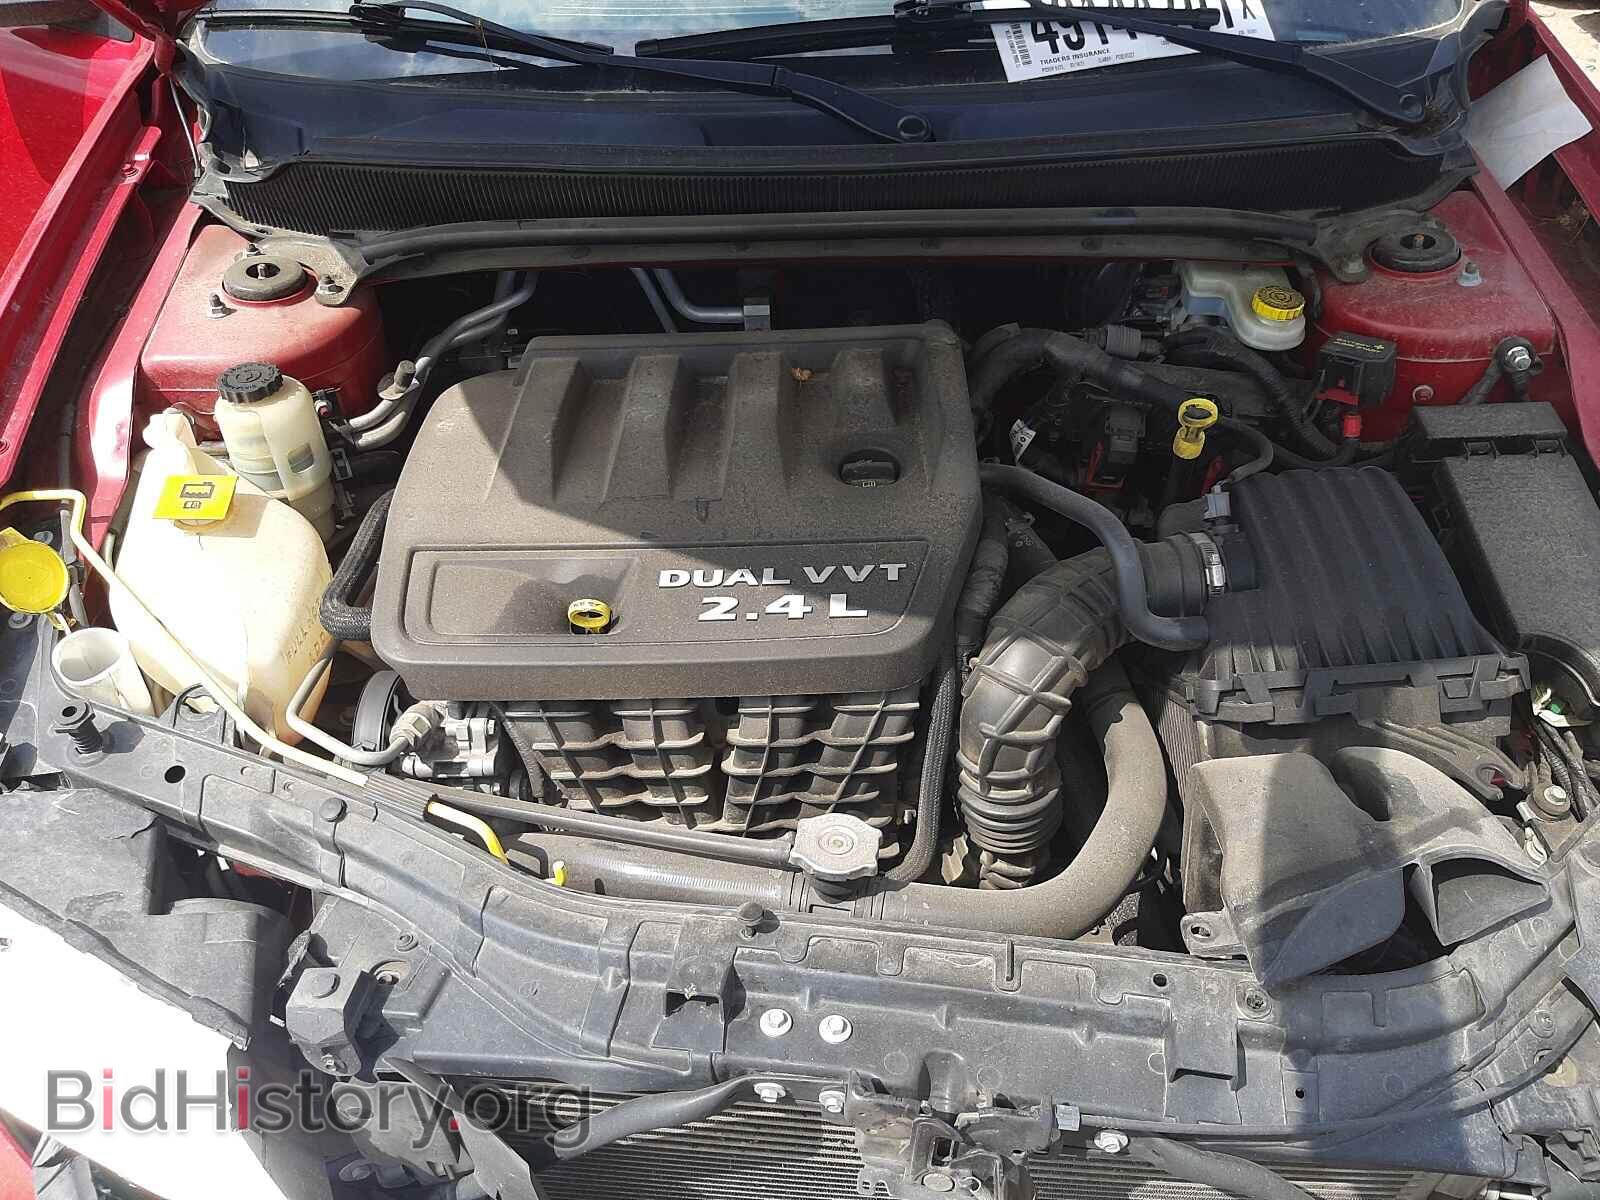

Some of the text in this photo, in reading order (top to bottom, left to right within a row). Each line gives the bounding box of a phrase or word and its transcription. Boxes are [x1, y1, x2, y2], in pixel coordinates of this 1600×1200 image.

[1040, 55, 1071, 65] TRADERS
[1072, 49, 1111, 60] INSURANCE
[658, 563, 907, 588] DUAL VVT
